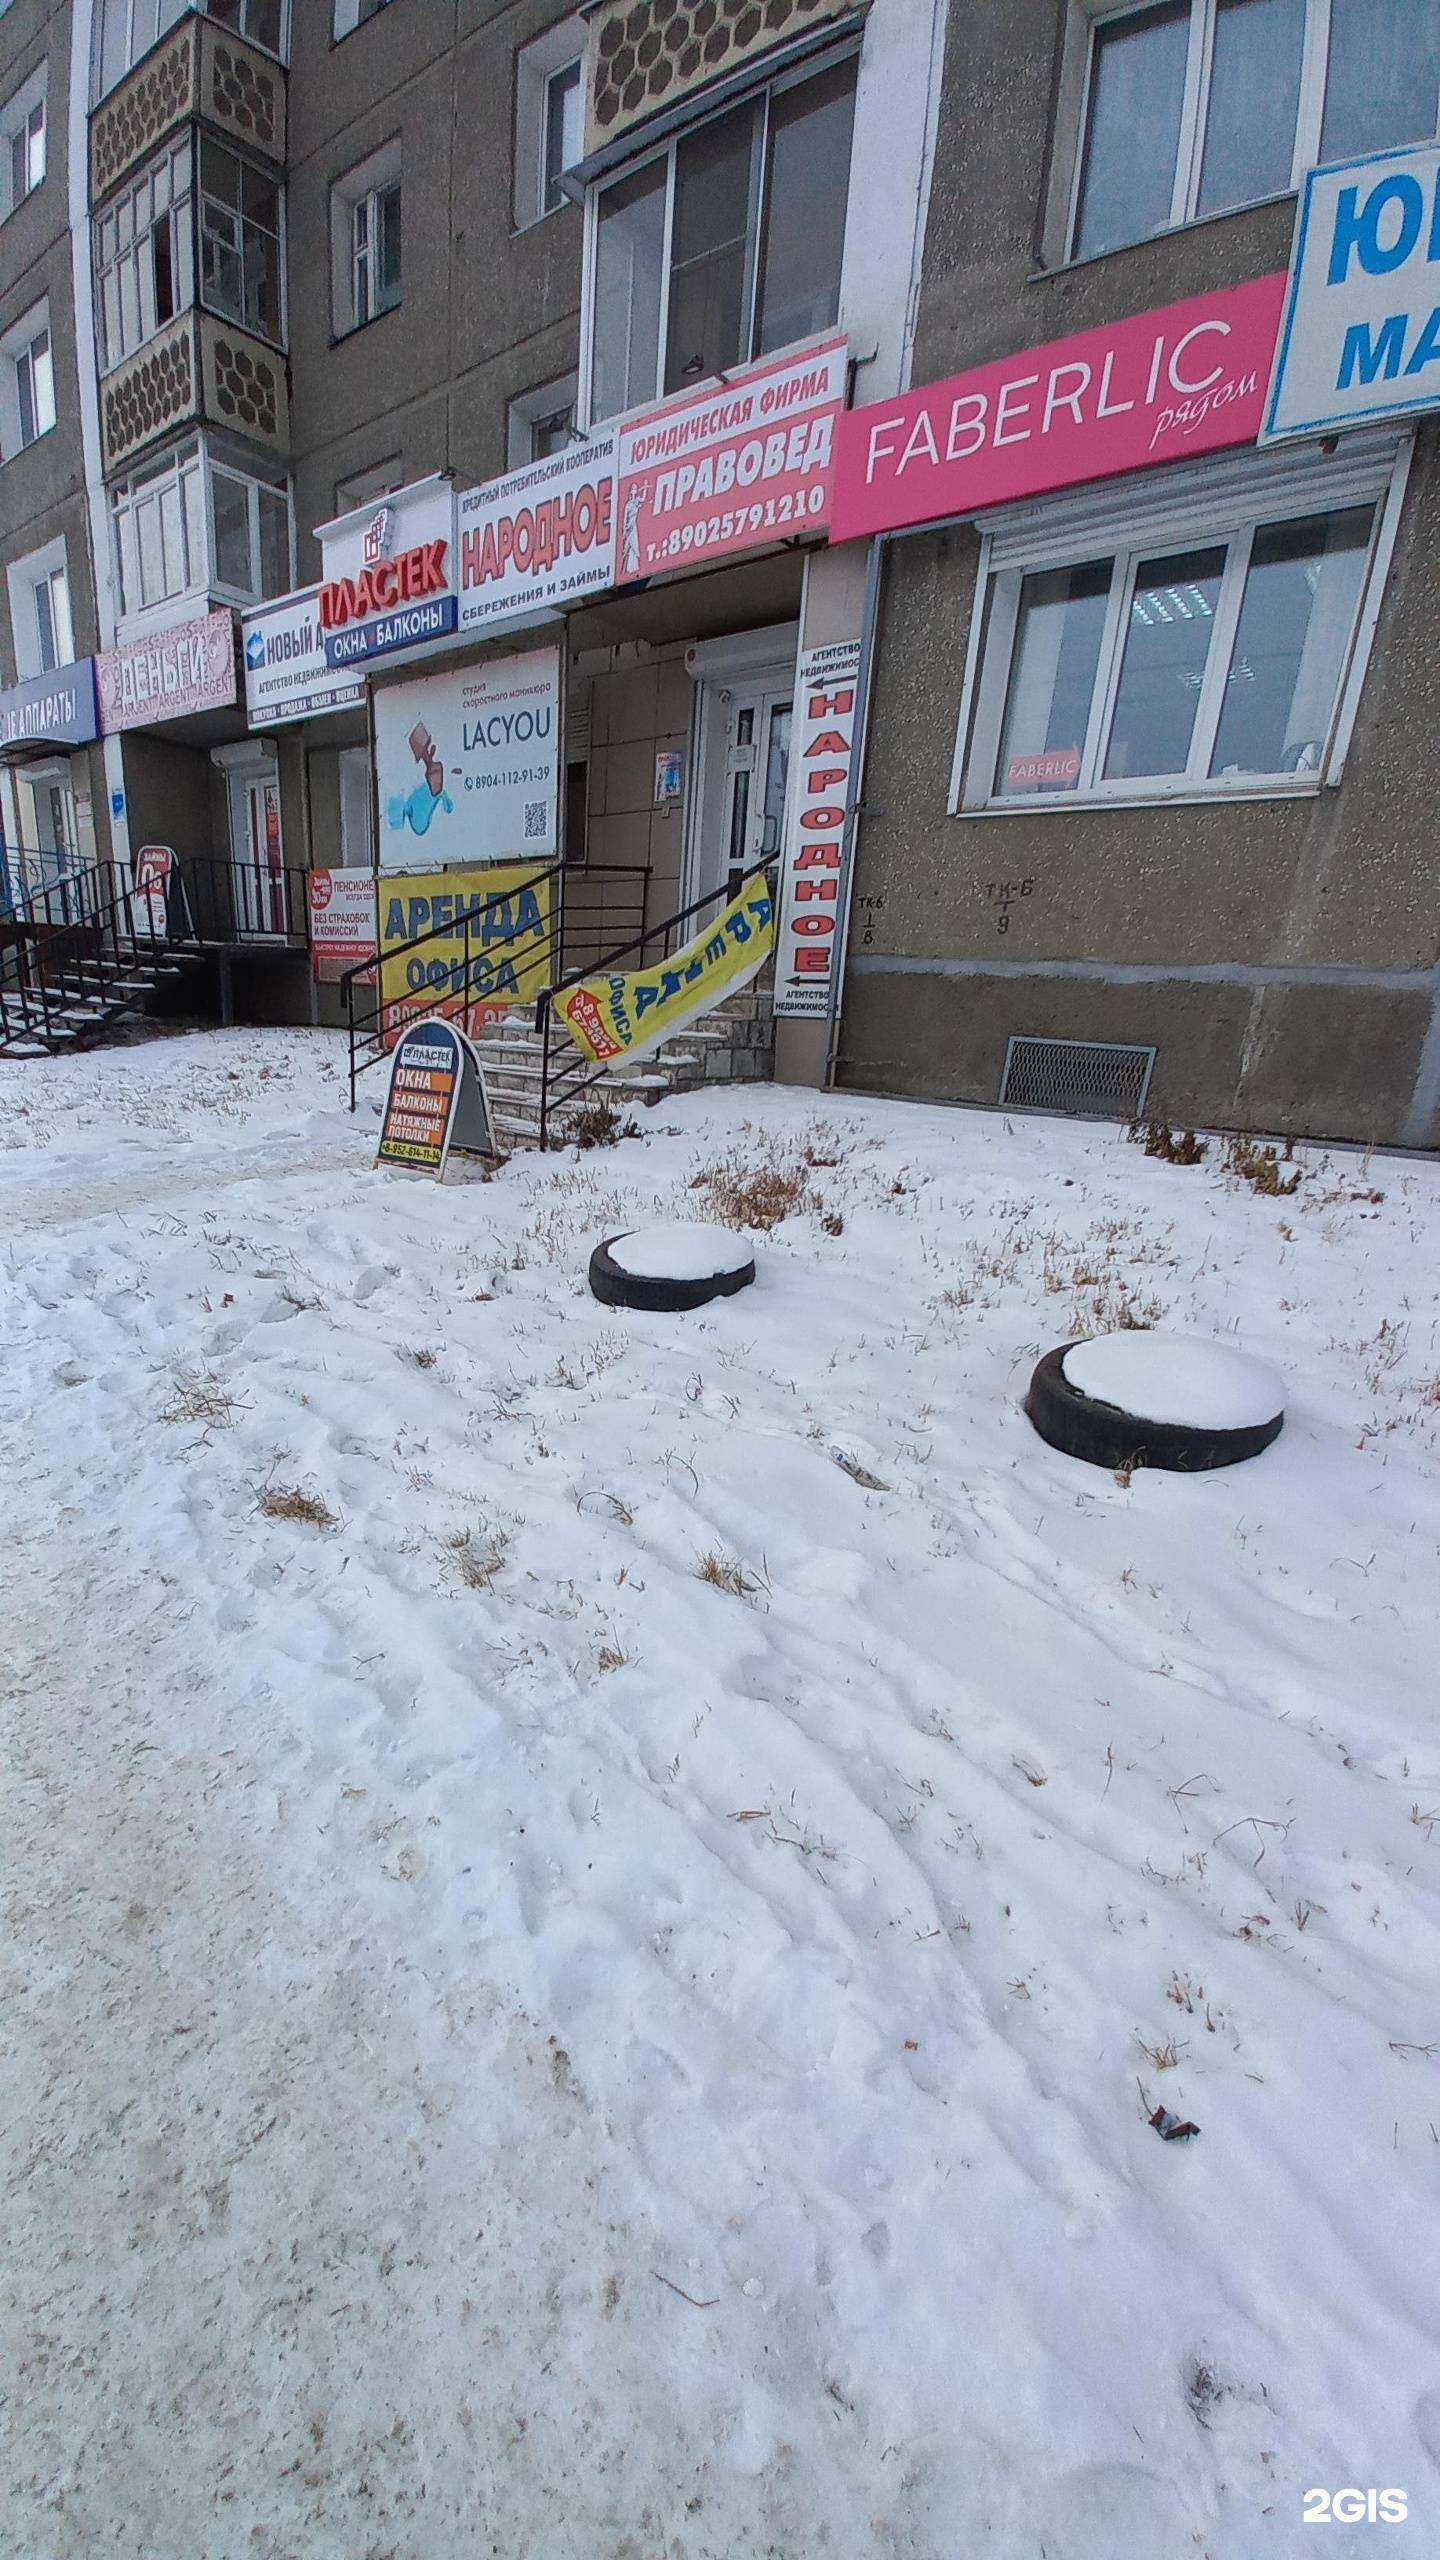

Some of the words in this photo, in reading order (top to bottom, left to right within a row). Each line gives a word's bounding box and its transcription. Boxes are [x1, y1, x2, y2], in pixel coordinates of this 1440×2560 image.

[1326, 168, 1440, 286] Ю
[631, 396, 753, 465] ЮРИДИЧЕСКАЯ
[760, 367, 828, 414] ФИРМА
[865, 320, 1232, 483] FABERLIC
[1149, 369, 1258, 450] рядом
[462, 485, 499, 513] КРЕДИТНЫЙ
[500, 458, 565, 498] ПОТРЕБИТЕЛЬСКИЙ
[566, 439, 614, 473] КООПЕРАТИВ
[653, 414, 835, 516] ПРАВОВЕД
[462, 476, 612, 590] НАРОДНОЕ
[319, 539, 449, 629] ПЛАСТЕК
[462, 586, 543, 621] СБЕРЕЖЕНИЯ
[547, 583, 556, 596] И
[560, 565, 610, 593] ЗАЙМЫ
[267, 616, 314, 666] НОВЫЙ
[334, 636, 368, 660] ОКНА
[376, 604, 443, 646] БАЛКОНЫ
[811, 643, 861, 662] АГЕНТСТВО
[120, 638, 208, 702] ДЕНЬГИ
[197, 675, 234, 698] ARGENT
[258, 674, 293, 695] АГЕНТСТВО
[800, 658, 860, 677] НЕДВИЖИМОС
[19, 688, 76, 739] АППАРАТЫ
[462, 692, 508, 709] скоростного
[509, 682, 551, 699] маникюра
[463, 707, 551, 751] LACYOU
[475, 766, 550, 790] 8904-112-91-39
[1009, 760, 1078, 777] FABERLIC
[791, 689, 854, 972] НАРОДНОЕ
[314, 913, 327, 923] БЕЗ
[328, 912, 370, 924] СТРАХОВОК
[320, 924, 359, 936] КОМИССИЙ
[385, 890, 544, 947] АРЕНДА
[406, 957, 520, 994] ОФИСА
[412, 1048, 451, 1062] ПЛАСТЕК
[395, 1069, 431, 1089] ОКНА
[389, 1112, 440, 1131] НАТЯЖНЫЕ
[393, 1093, 443, 1113] БАЛКОНЫ
[388, 1125, 429, 1142] ПОТОЛКИ
